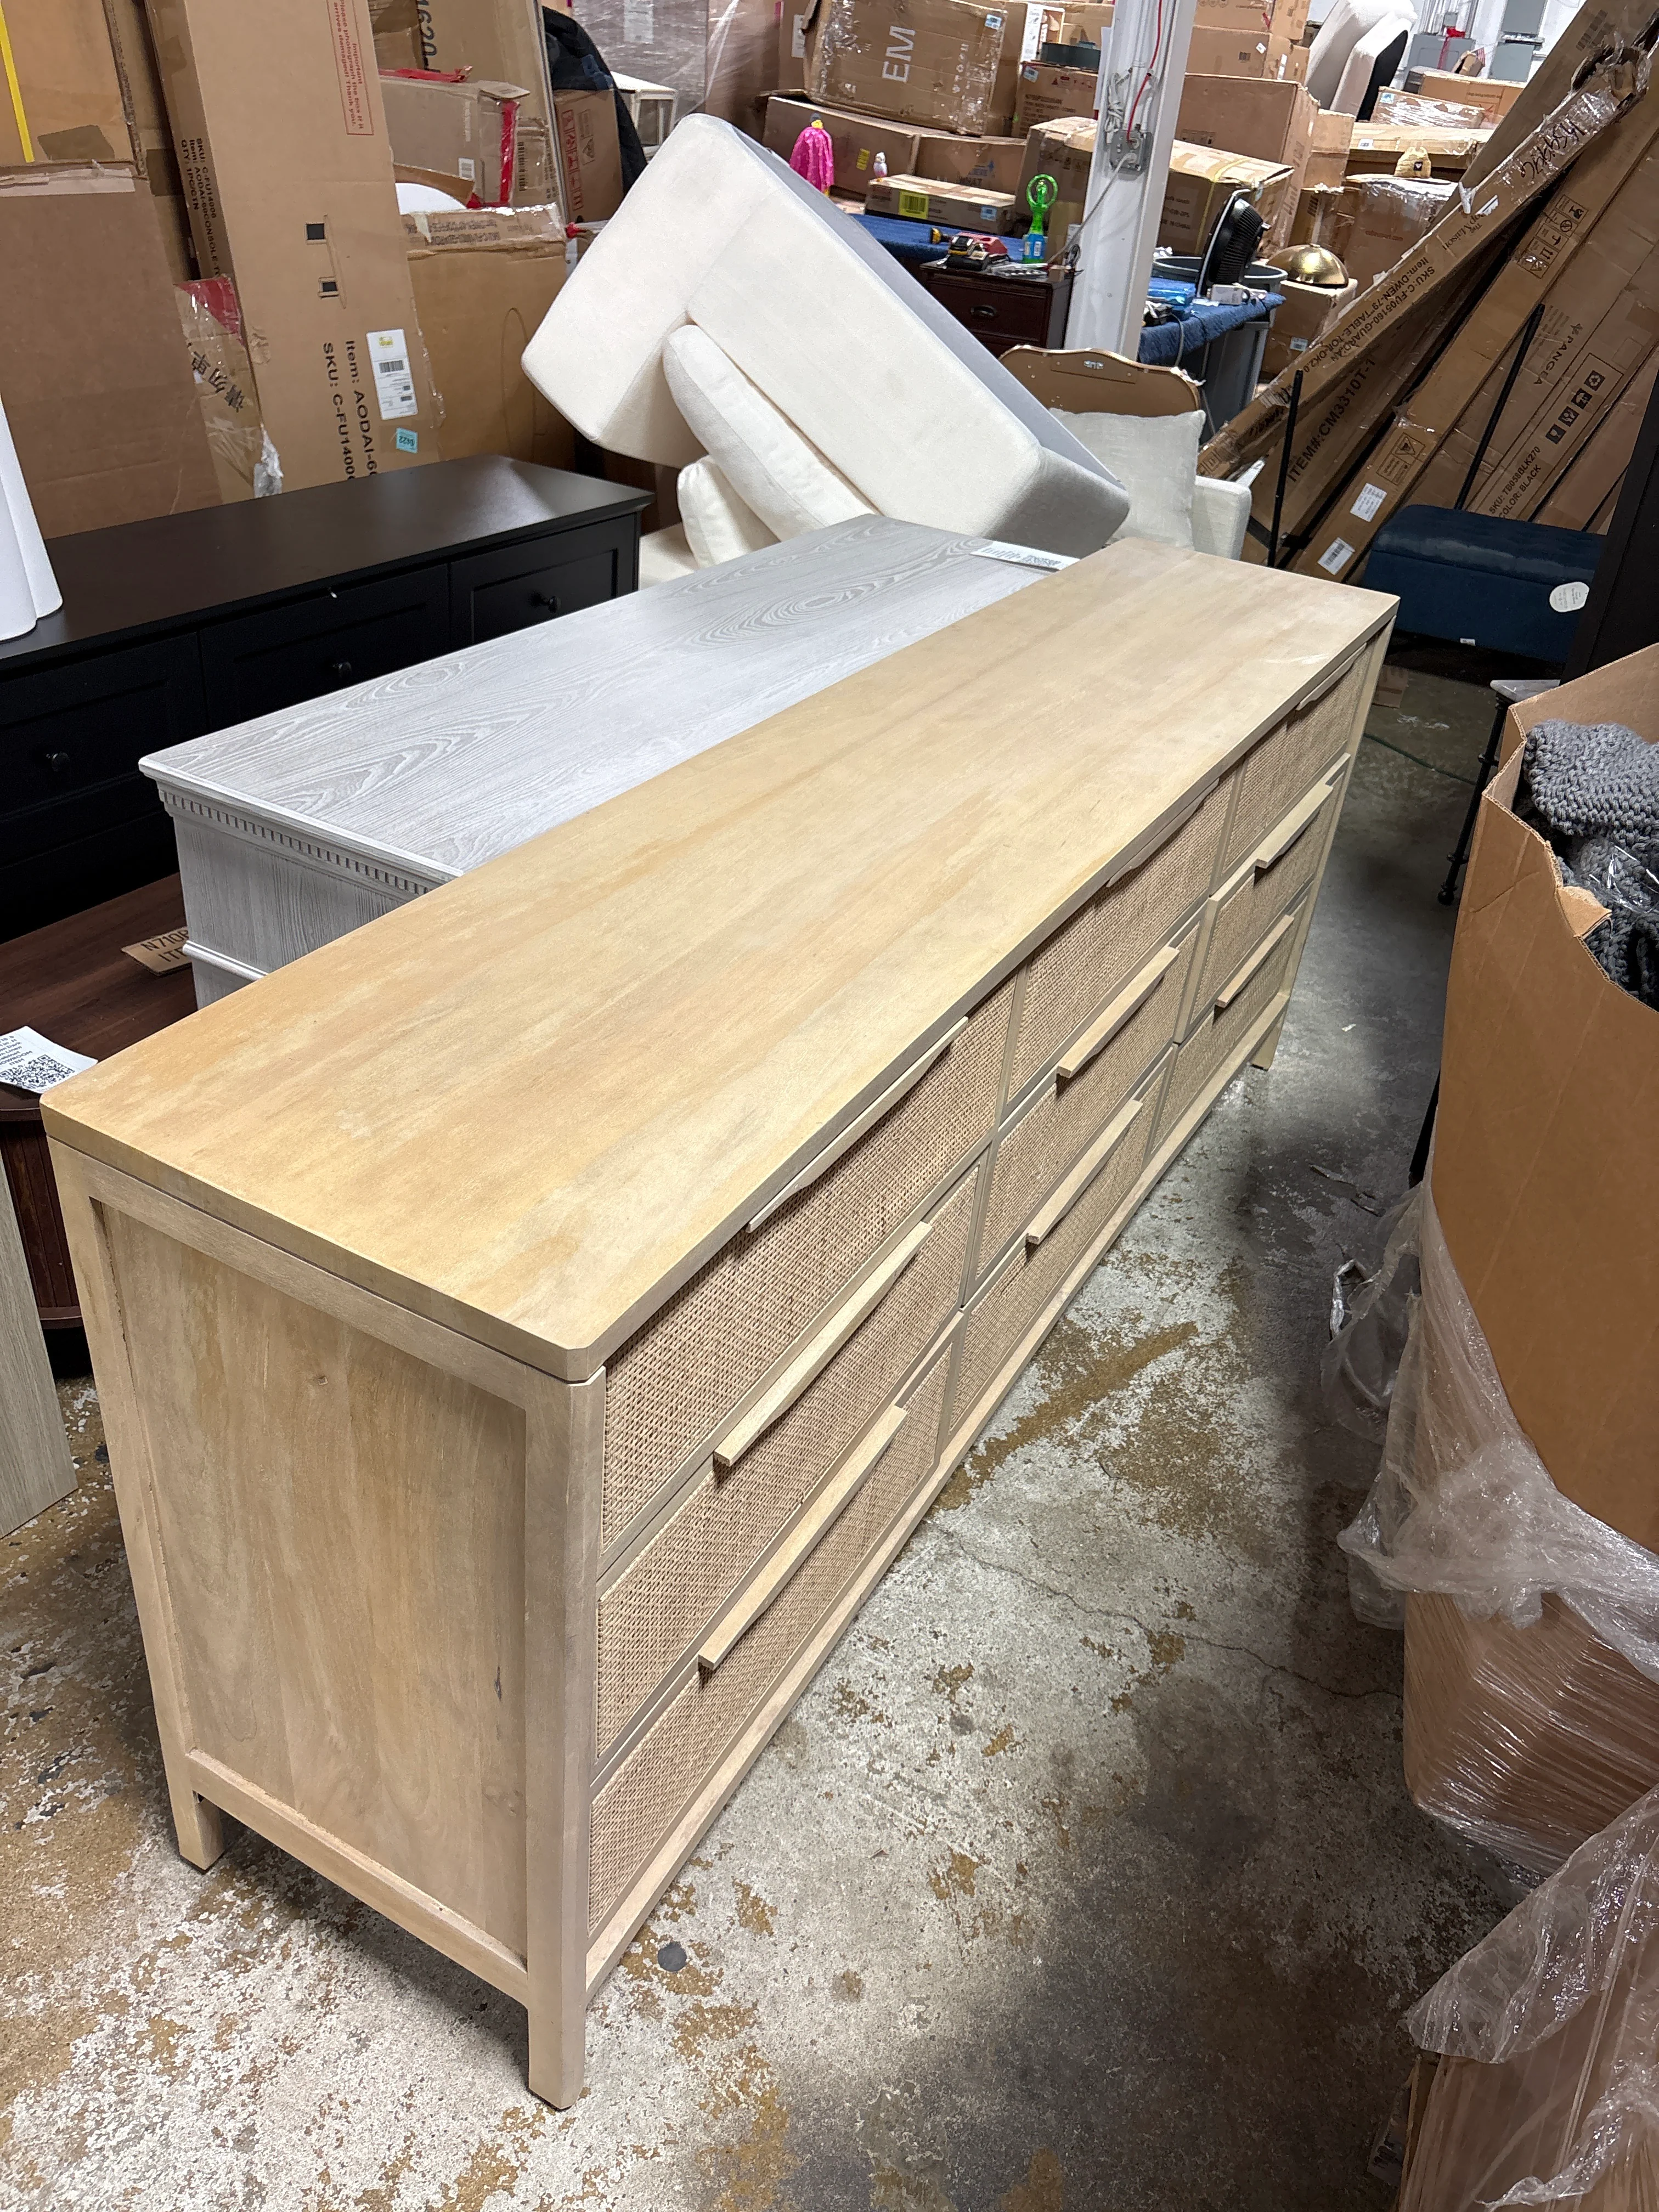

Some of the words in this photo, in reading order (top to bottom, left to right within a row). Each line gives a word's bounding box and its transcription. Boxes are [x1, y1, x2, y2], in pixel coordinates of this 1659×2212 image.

[352, 43, 363, 84] Important
[882, 25, 917, 83] EM
[196, 138, 206, 163] SKU:
[323, 342, 339, 387] SKU:
[345, 340, 360, 383] Item:
[1519, 464, 1542, 492] BLACK
[1488, 494, 1505, 515] SKU:
